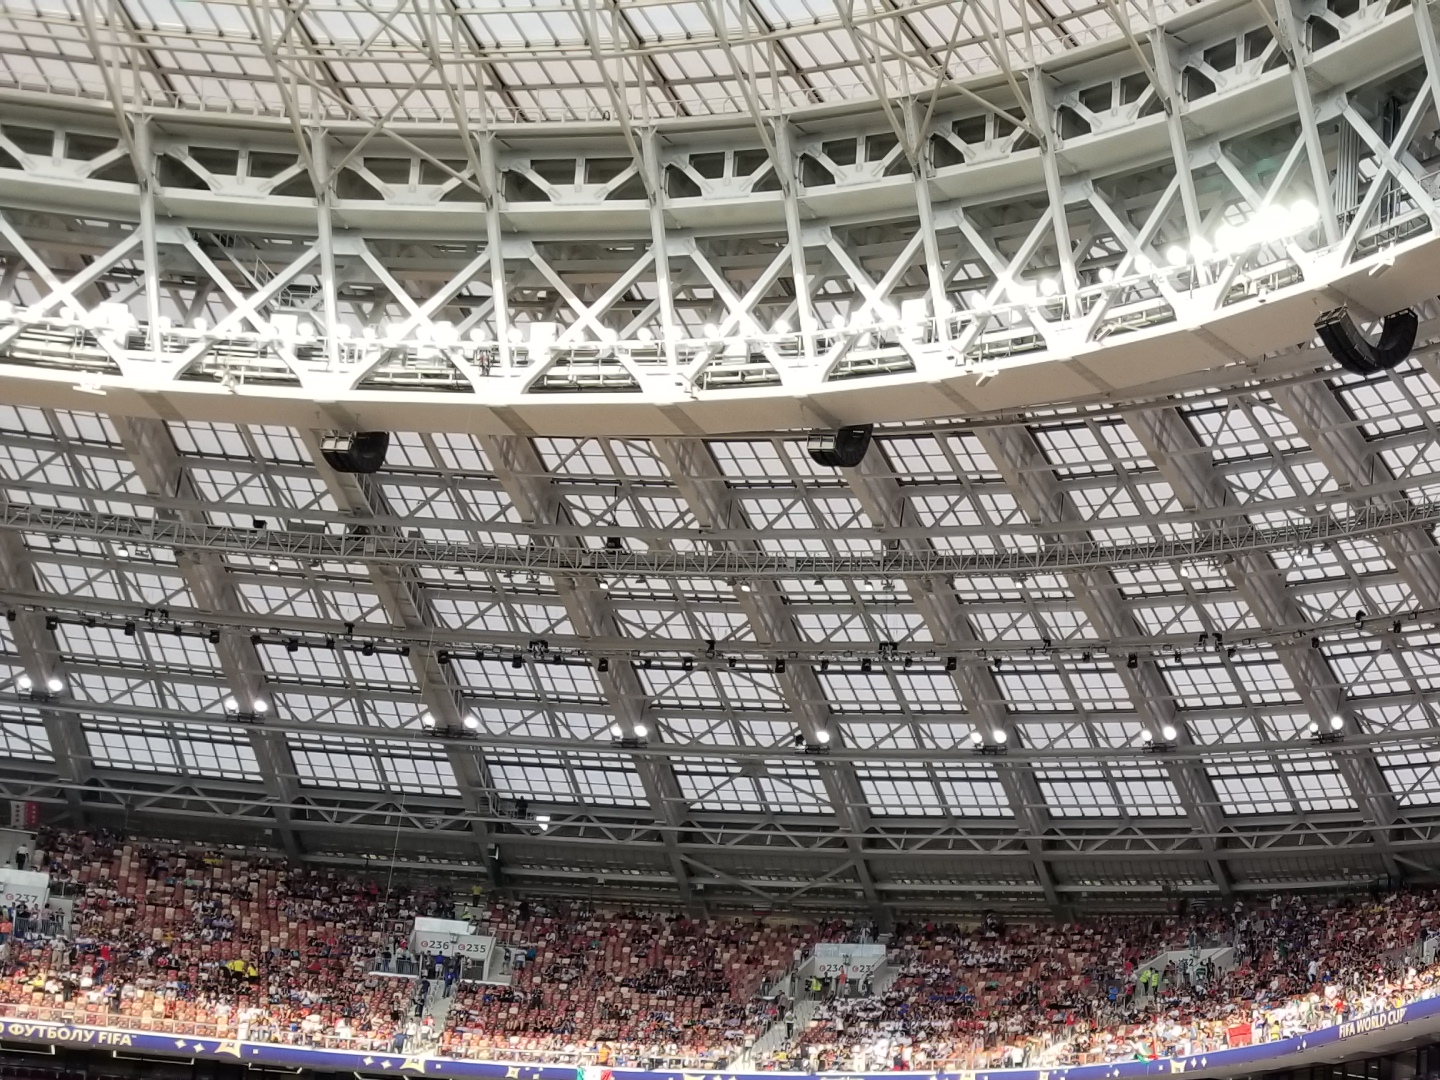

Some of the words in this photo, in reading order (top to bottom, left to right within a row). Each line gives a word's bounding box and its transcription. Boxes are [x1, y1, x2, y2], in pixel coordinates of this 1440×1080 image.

[8, 1023, 95, 1042] ФУТБОЛУ
[1339, 1021, 1355, 1039] FIFA
[1356, 1012, 1387, 1034] WORLD
